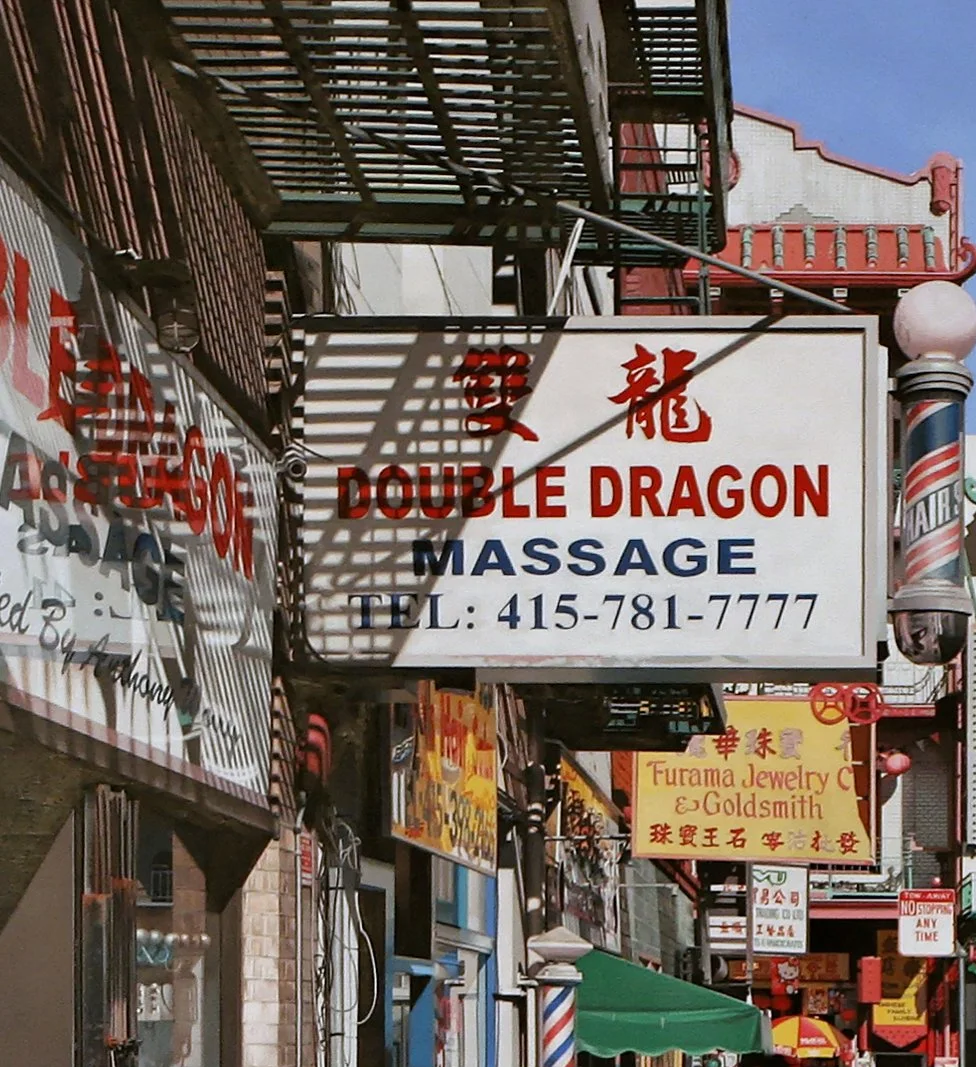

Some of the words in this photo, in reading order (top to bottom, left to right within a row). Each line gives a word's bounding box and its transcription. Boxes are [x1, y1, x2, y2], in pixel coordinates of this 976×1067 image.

[337, 465, 567, 520] DOUBLE
[590, 463, 830, 518] DRAGON
[905, 487, 951, 546] HAIR
[412, 537, 757, 577] MASSAGE
[348, 592, 476, 631] TEL:
[496, 592, 818, 631] 415-781-7777
[646, 761, 734, 788] Furama
[741, 764, 830, 795] Jewelry
[702, 791, 824, 820] Goldsmith
[901, 900, 916, 916] NO
[916, 919, 937, 928] ANY
[916, 931, 939, 942] TIME
